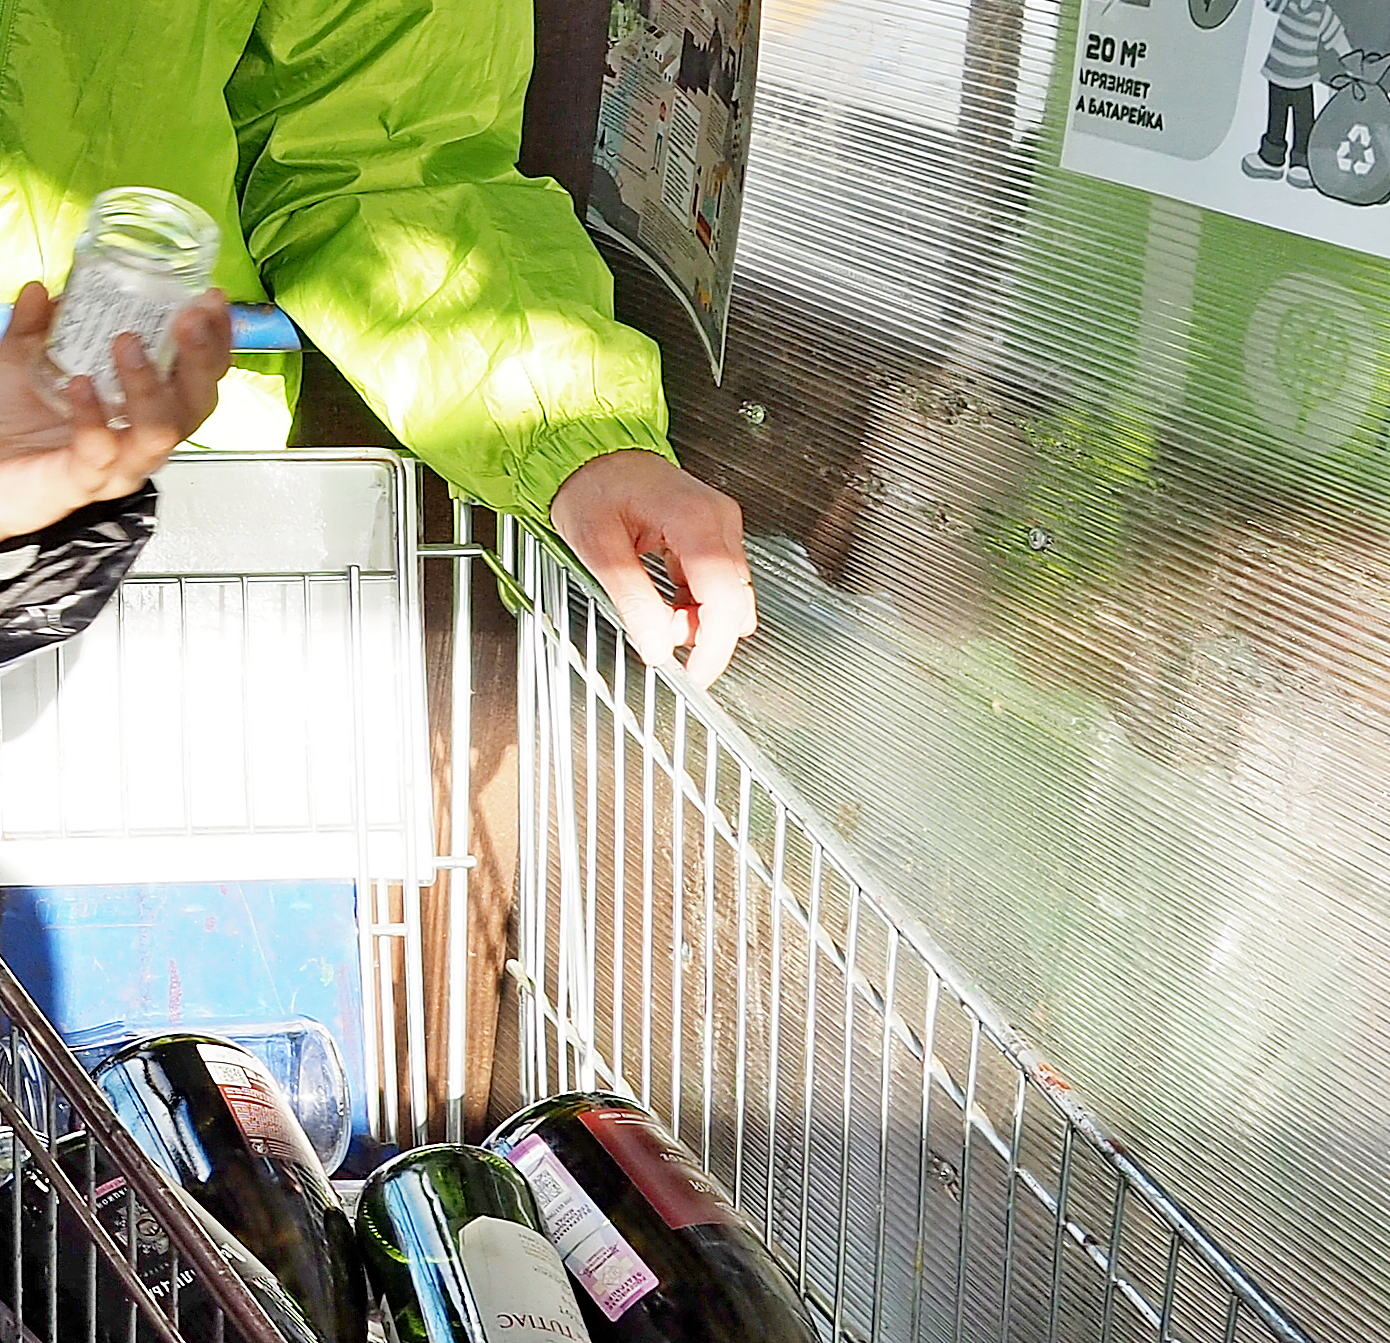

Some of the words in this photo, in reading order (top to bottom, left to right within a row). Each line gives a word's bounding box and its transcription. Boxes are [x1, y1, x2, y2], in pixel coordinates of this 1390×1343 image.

[1086, 33, 1116, 63] 20
[1075, 95, 1085, 112] А
[1088, 97, 1163, 132] БАТАРЕЙКА
